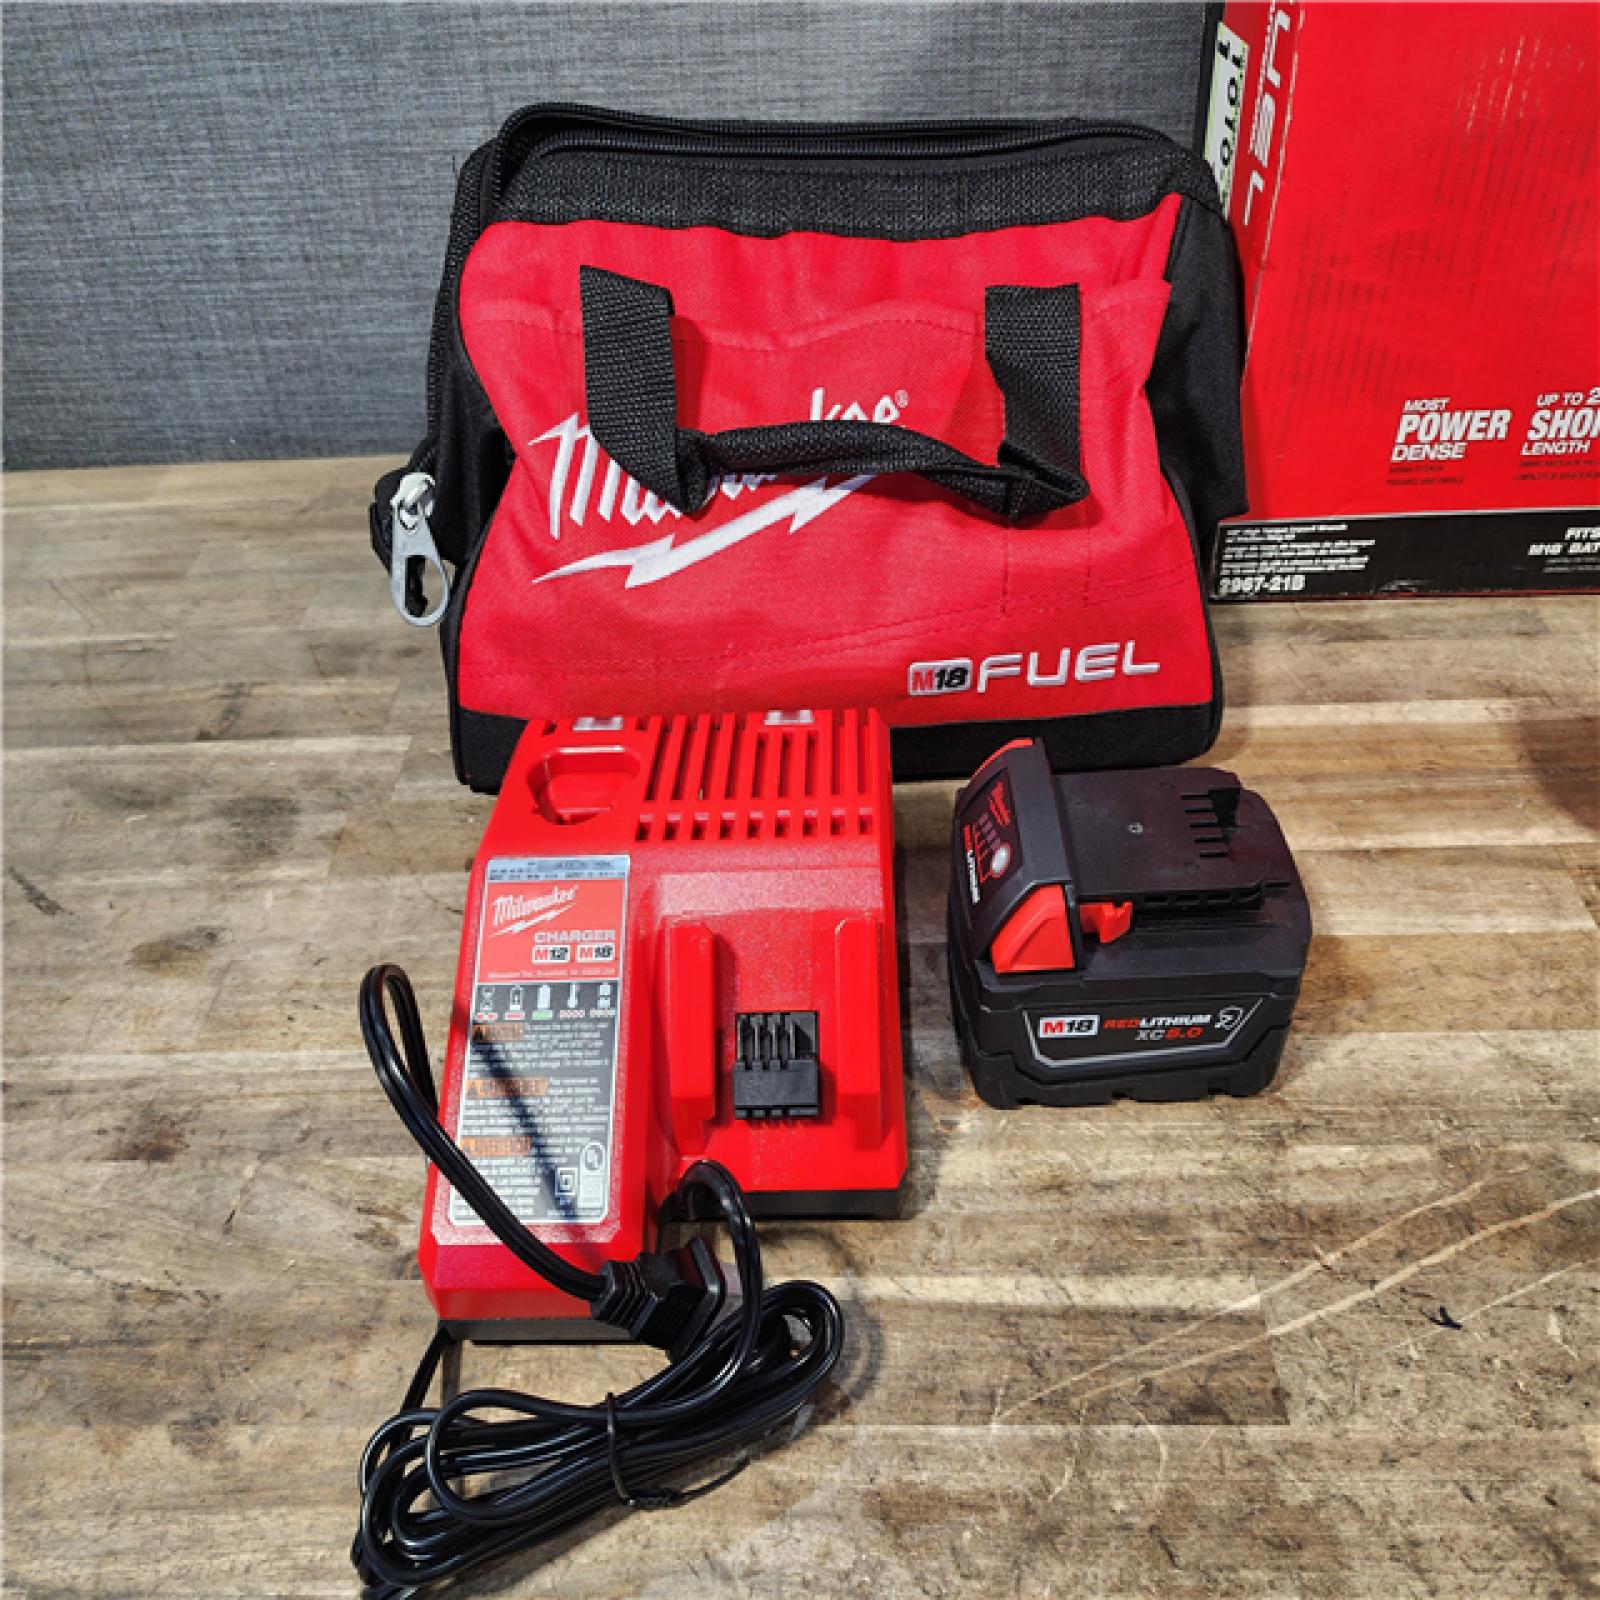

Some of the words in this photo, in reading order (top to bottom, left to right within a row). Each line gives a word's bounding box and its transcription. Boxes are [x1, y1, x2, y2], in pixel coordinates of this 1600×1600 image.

[1403, 397, 1450, 411] MOST
[1536, 393, 1560, 406] UP
[1562, 392, 1583, 405] TO
[1395, 409, 1512, 444] POWER
[1390, 441, 1468, 462] DENSE
[1520, 440, 1591, 456] LENGTH
[910, 664, 971, 693] M18
[977, 640, 1161, 693] FUEL
[534, 929, 616, 944] CHARGER
[1041, 1017, 1097, 1037] M18
